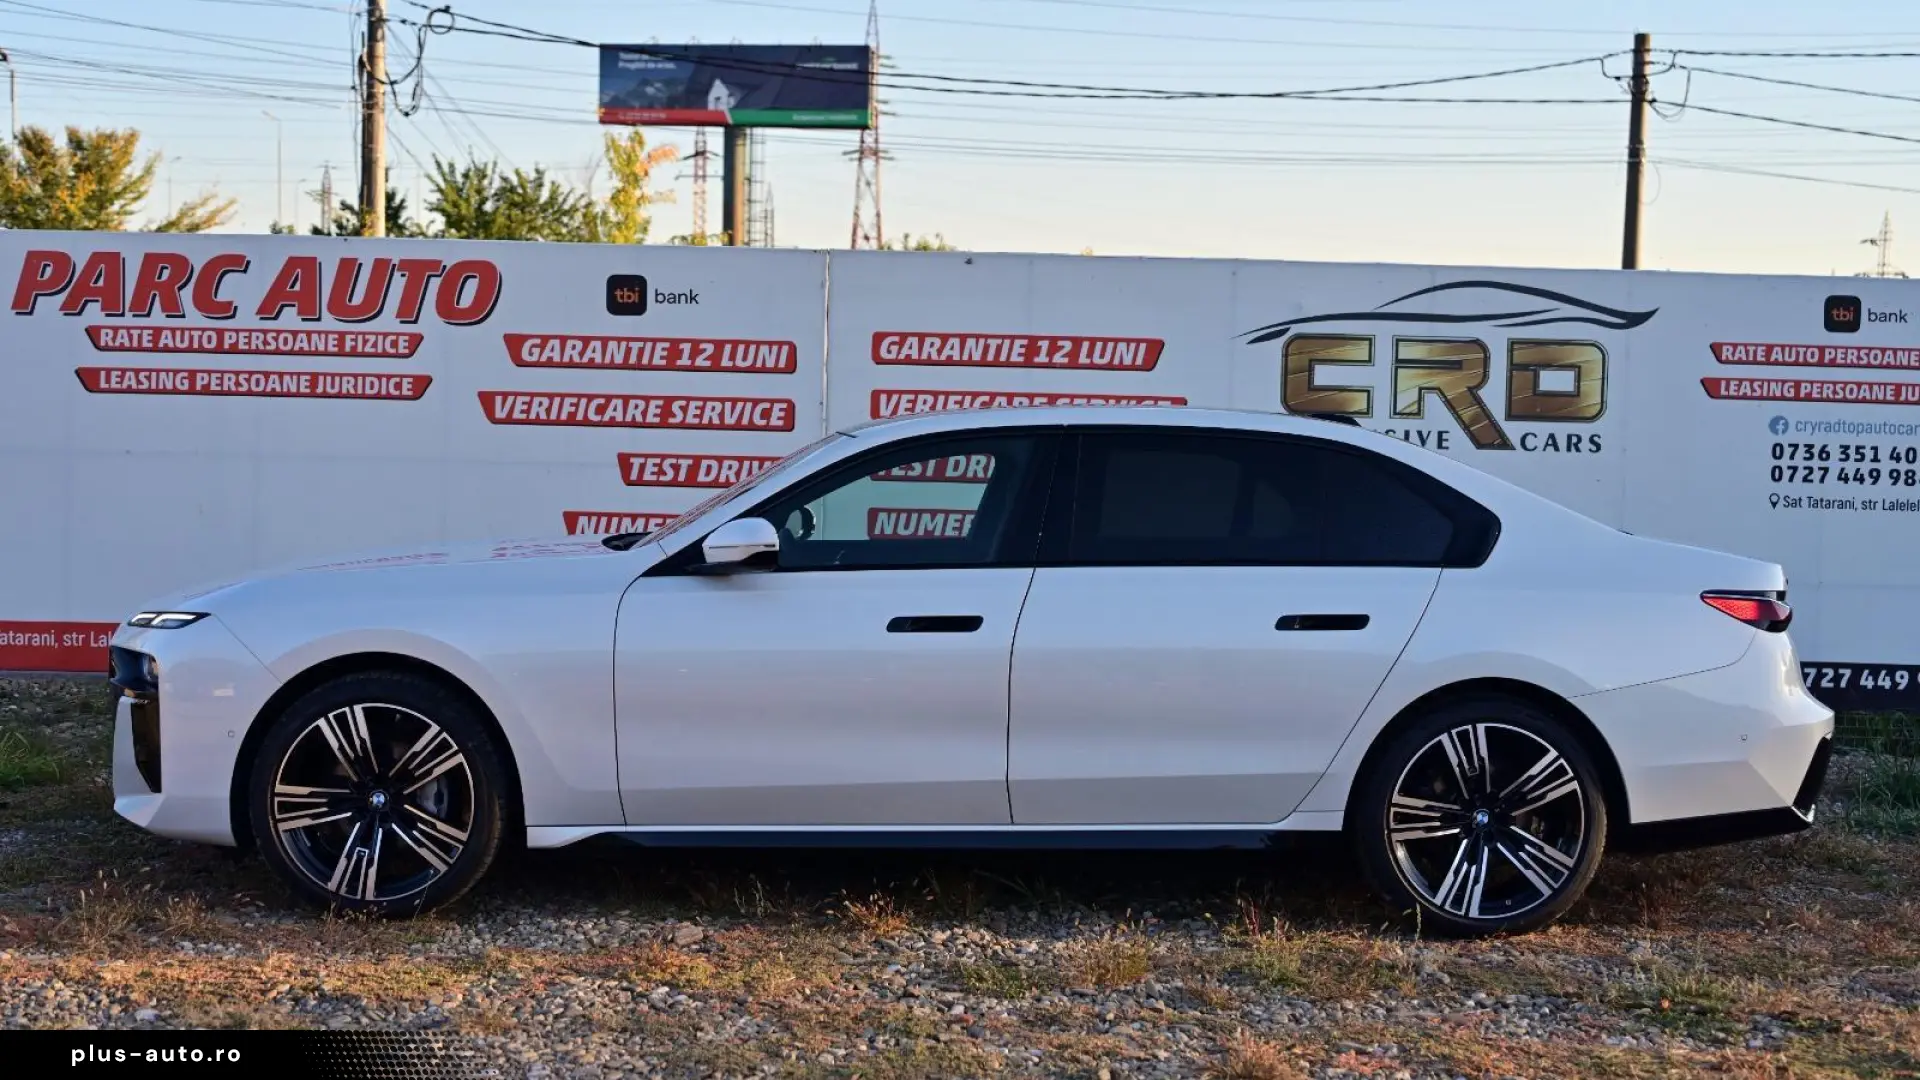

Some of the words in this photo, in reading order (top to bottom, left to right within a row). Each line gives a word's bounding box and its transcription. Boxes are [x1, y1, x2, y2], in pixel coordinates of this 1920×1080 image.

[11, 249, 252, 321] PARC
[255, 254, 502, 325] AUTO
[615, 287, 640, 304] tbi
[654, 289, 699, 305] bank
[1831, 307, 1854, 321] tbi
[1867, 308, 1908, 323] bank
[100, 328, 153, 349] RATE
[158, 329, 217, 351] AUTO
[223, 330, 338, 353] PERSOANE
[344, 333, 410, 355] FIZICE
[521, 338, 668, 366] GARANTIE
[676, 342, 715, 367] 12
[720, 344, 789, 368] LUNI
[879, 336, 1029, 363] GARANTIE
[1033, 340, 1071, 364] 12
[1078, 341, 1148, 366] LUNI
[1721, 345, 1766, 361] RATE
[1770, 346, 1819, 363] AUTO
[1824, 348, 1920, 367] PERSOANE
[100, 370, 189, 391] LEASING
[195, 372, 312, 394] PERSOANE
[316, 374, 413, 396] JURIDICE
[1280, 333, 1609, 450] CRD
[1720, 379, 1795, 397] LEASING
[1800, 382, 1895, 401] PERSOANE
[1899, 385, 1920, 402] JU
[494, 396, 665, 423] VERIFICARE
[667, 400, 787, 426] SERVICE
[1519, 431, 1603, 454] CARS
[1771, 442, 1831, 461] 0736
[1838, 444, 1881, 463] 351
[1889, 446, 1918, 464] 40
[629, 457, 694, 482] TEST
[877, 459, 937, 477] ST
[1770, 465, 1830, 483] 0727
[1837, 467, 1881, 486] 449
[1888, 468, 1920, 487] 98
[1782, 494, 1803, 509] Sat
[1806, 495, 1857, 512] Tatarani,
[1861, 498, 1878, 511] str
[0, 630, 58, 649] atarani,
[63, 632, 86, 647] str
[1860, 669, 1909, 690] 449
